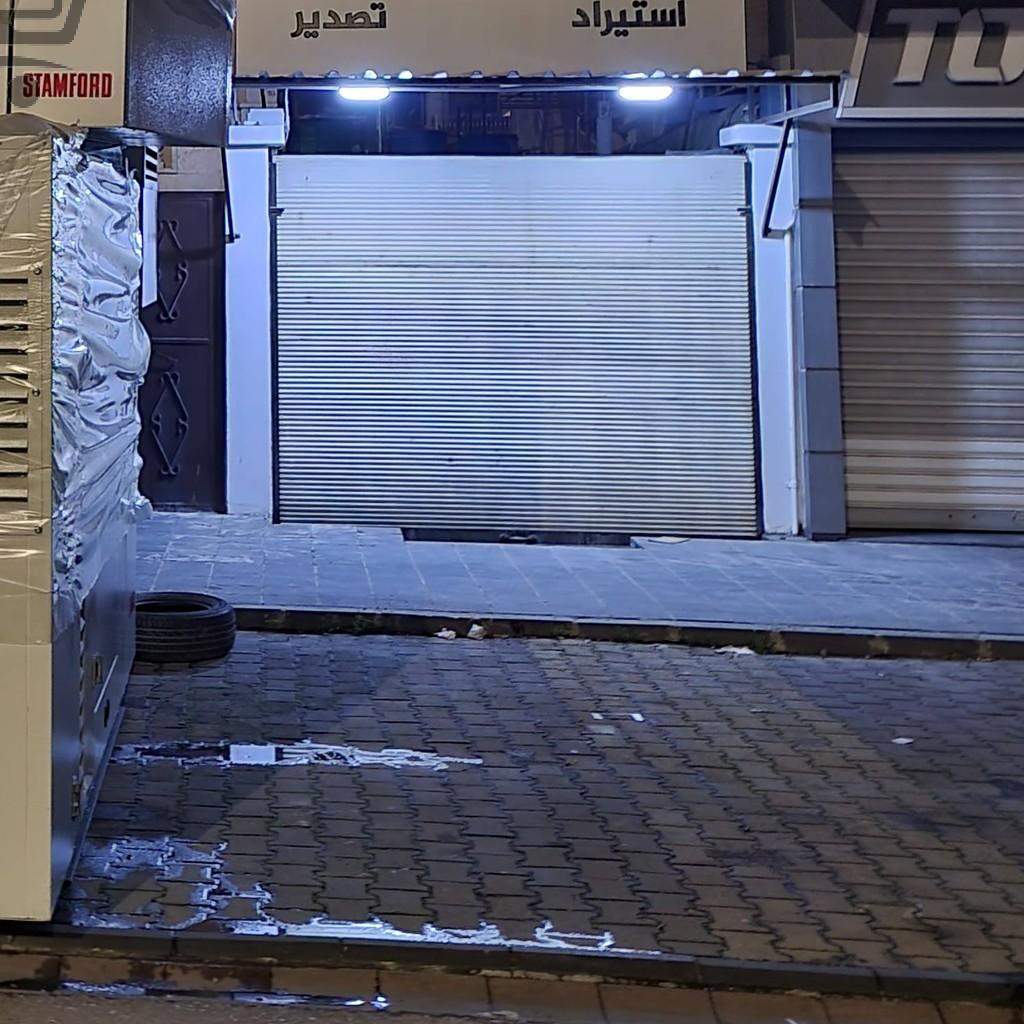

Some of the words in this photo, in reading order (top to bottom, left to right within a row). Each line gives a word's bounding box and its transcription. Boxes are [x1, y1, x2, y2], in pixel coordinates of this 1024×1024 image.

[290, 2, 387, 38] تصدير
[571, 0, 686, 38] استيراد
[23, 73, 113, 98] STAMFORD
